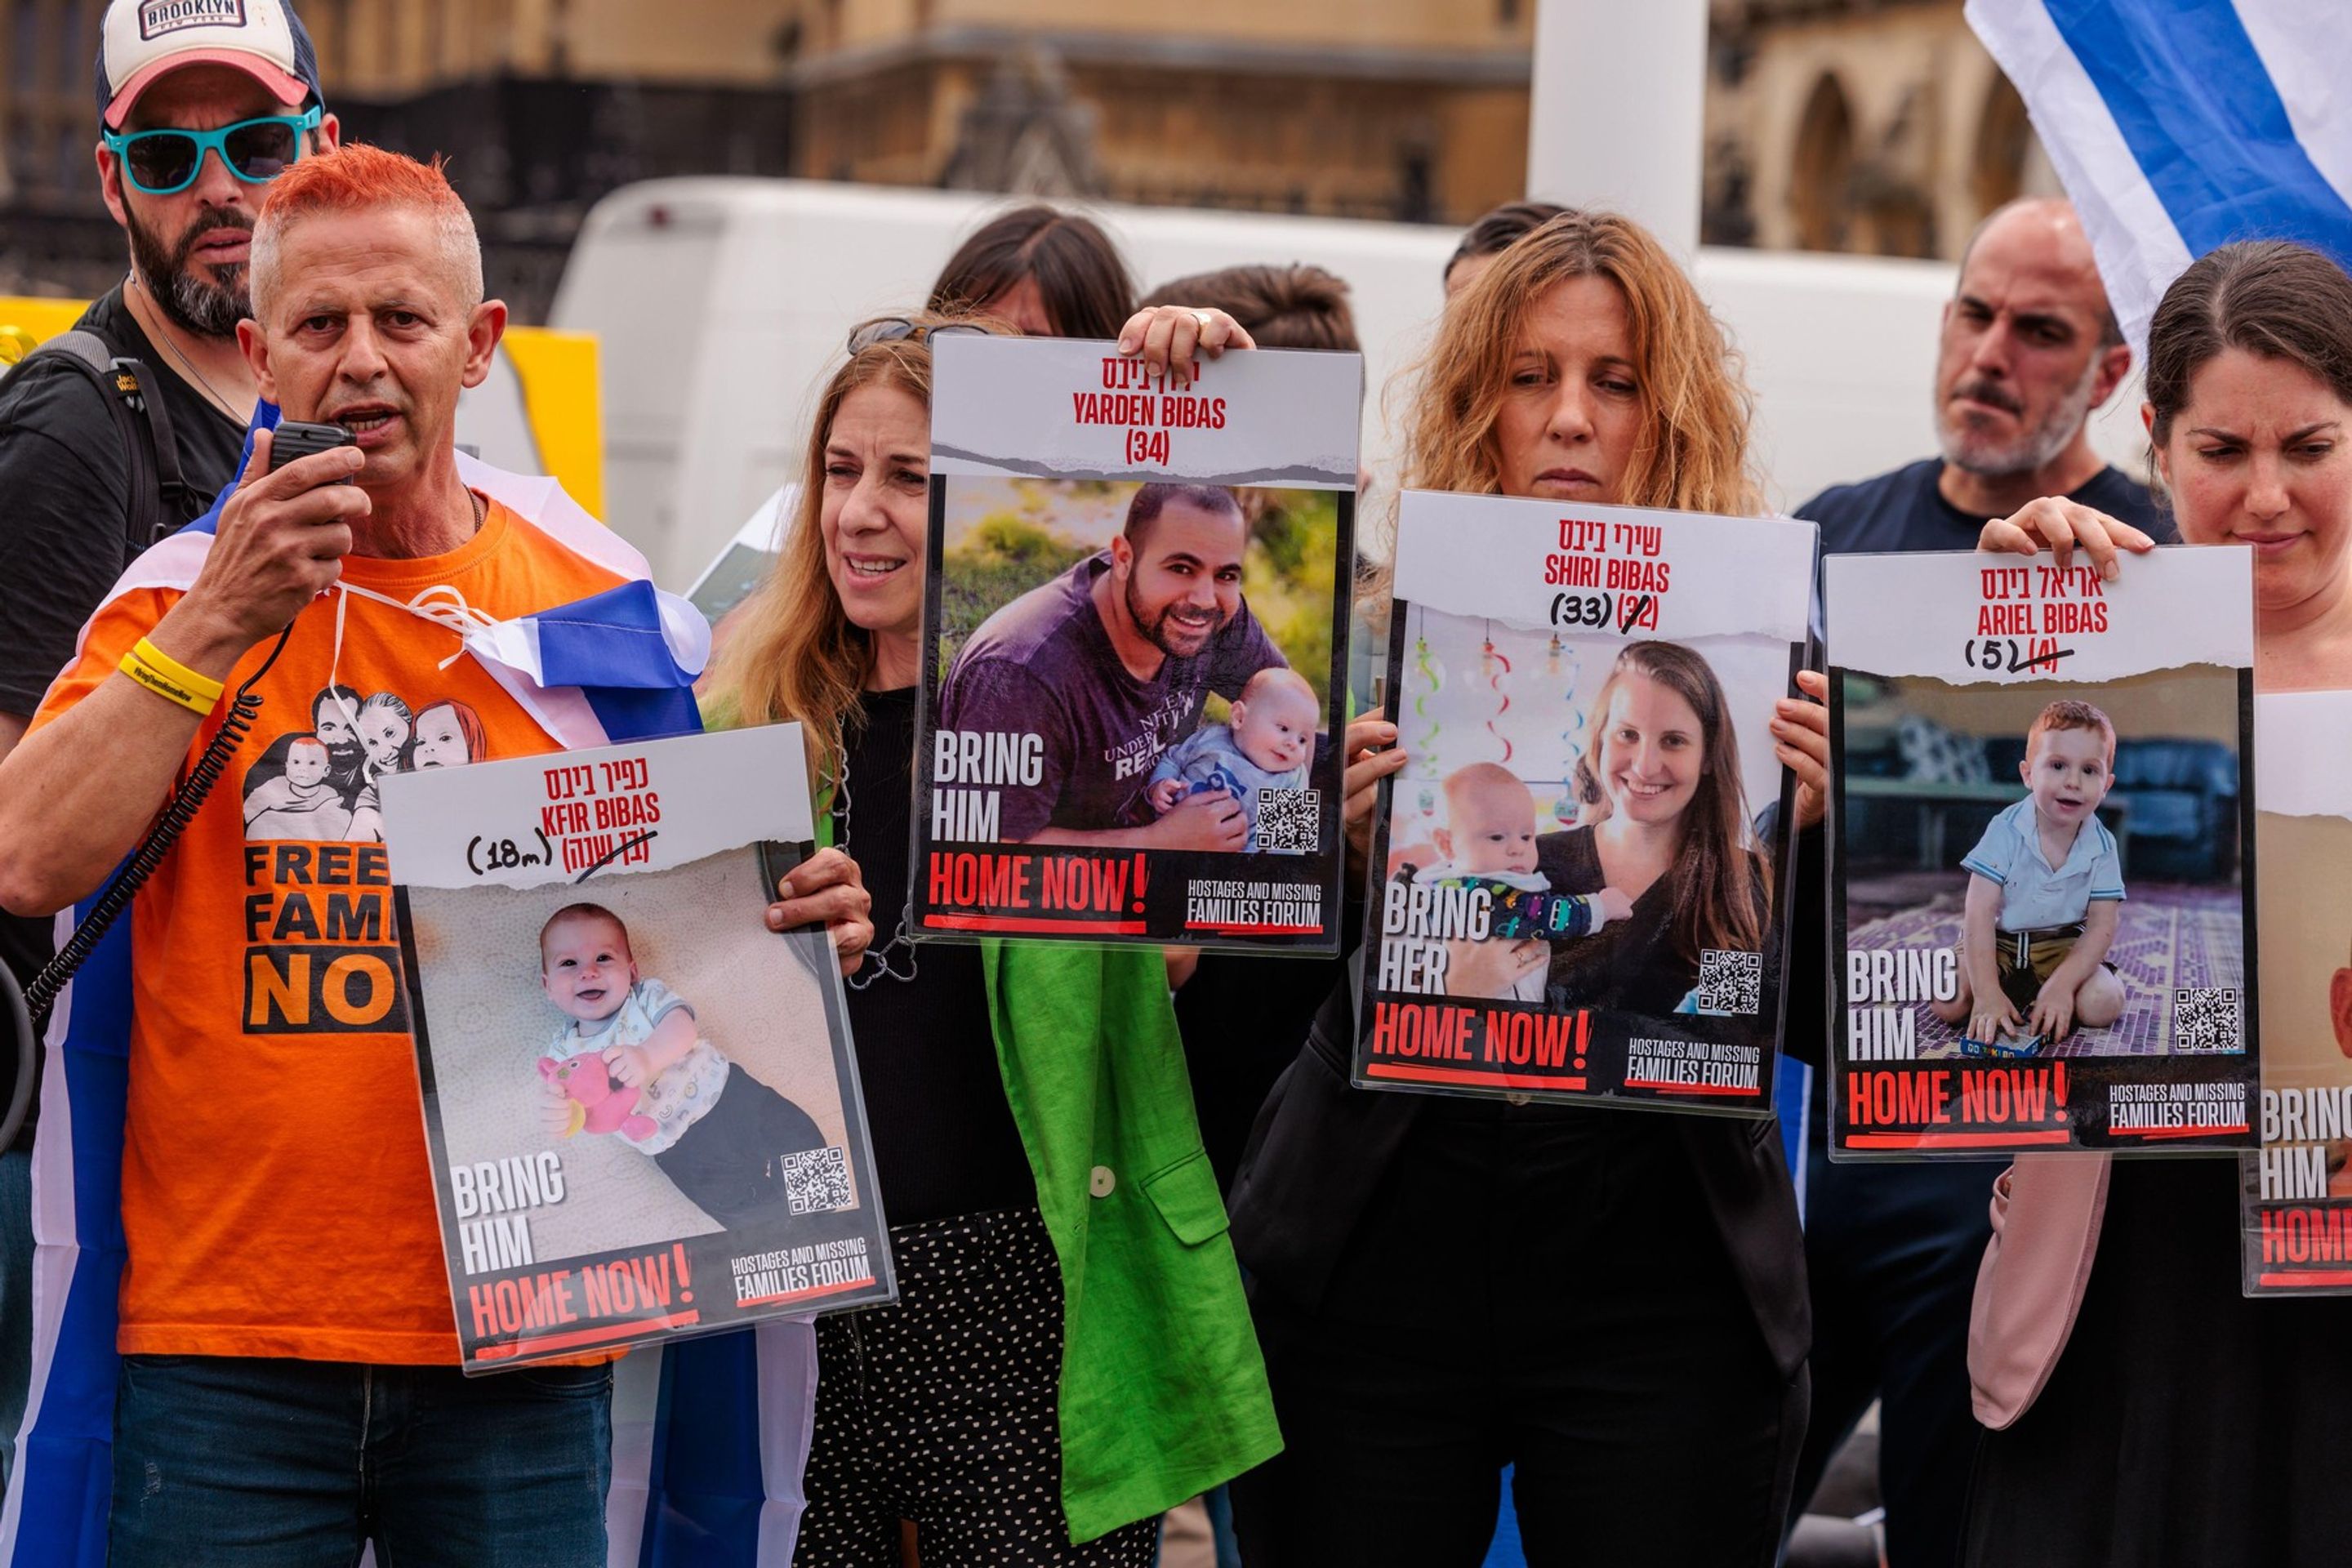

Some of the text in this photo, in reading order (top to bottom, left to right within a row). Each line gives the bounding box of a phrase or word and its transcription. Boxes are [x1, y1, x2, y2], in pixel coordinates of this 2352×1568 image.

[149, 0, 235, 26] BROOKLYN
[1072, 392, 1227, 430] YARDEN BIBAS
[1125, 428, 1170, 466] (34)
[1559, 519, 1662, 557] שירי ביבס
[1544, 554, 1670, 593] SHIRI BIBAS
[1980, 568, 2031, 600] ביבס
[1550, 592, 1612, 629] (33)
[1977, 601, 2109, 636] ARIEL BIBAS
[1965, 638, 2020, 674] (5)
[933, 729, 1044, 786] BRING
[1104, 730, 1154, 763] UNDER
[544, 758, 649, 800] כפיר ביבס
[541, 792, 661, 837] KFIR BIBAS
[931, 788, 1000, 844] HIM
[244, 844, 390, 887] FREE
[467, 826, 553, 875] (18m)
[929, 851, 1147, 914] HOME NOW!
[1188, 879, 1321, 902] HOSTAGES AND MISSING
[1187, 898, 1321, 928] FAMILIES FORUM
[1382, 880, 1492, 942] BRING
[1378, 940, 1447, 996] HER
[1847, 947, 1957, 1003] BRING
[249, 953, 395, 1026] NO
[1373, 1002, 1589, 1070] HOME NOW!
[1628, 1037, 1760, 1064] HOSTAGES AND MISSING
[1847, 1007, 1915, 1061] HIM
[1627, 1056, 1759, 1089] FAMILIES FORUM
[1848, 1061, 2069, 1125] HOME NOW!
[2109, 1082, 2245, 1102] HOSTAGES AND MISSING
[2109, 1102, 2246, 1129] FAMILIES FORUM
[451, 1151, 565, 1218] BRING
[2260, 1146, 2328, 1200] HIM
[459, 1214, 533, 1276] HIM
[731, 1236, 866, 1276] HOSTAGES AND MISSING
[469, 1243, 694, 1339] HOME NOW!
[734, 1255, 871, 1301] FAMILIES FORUM
